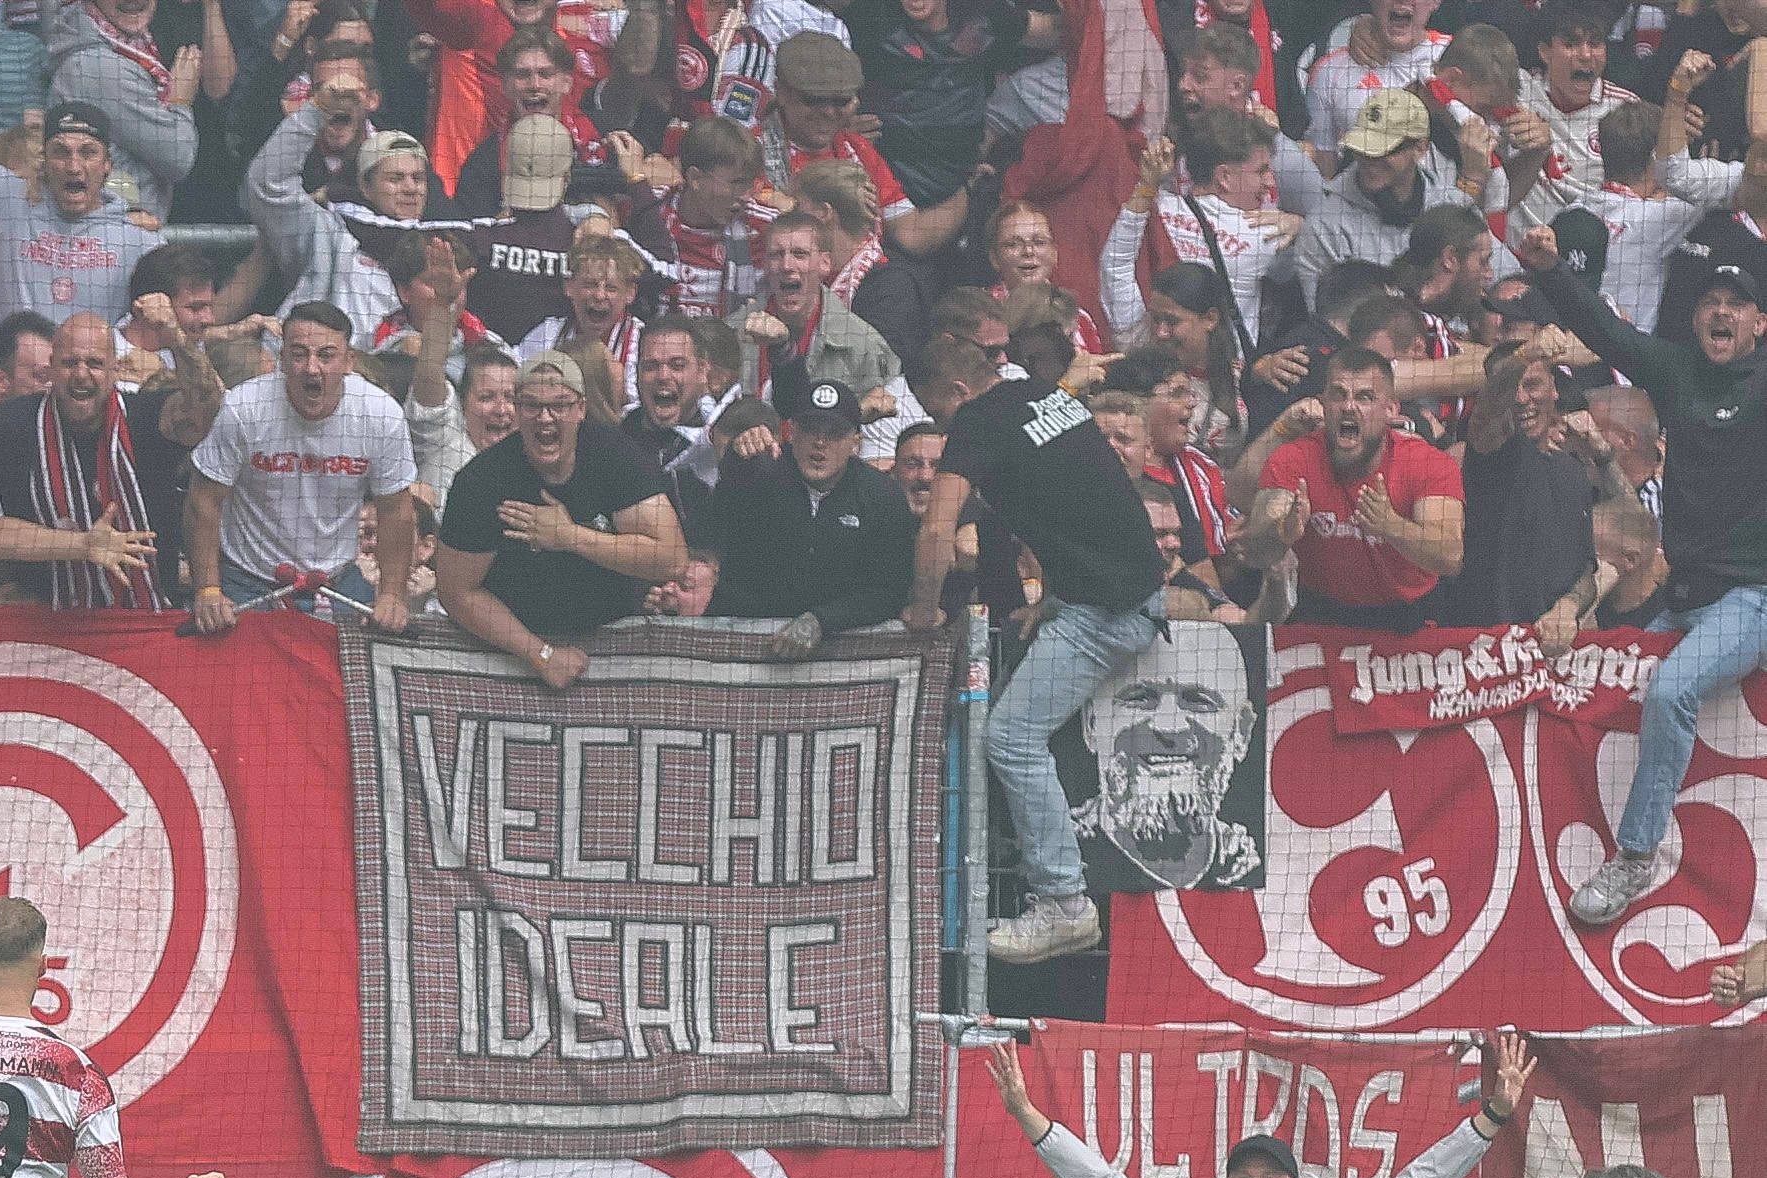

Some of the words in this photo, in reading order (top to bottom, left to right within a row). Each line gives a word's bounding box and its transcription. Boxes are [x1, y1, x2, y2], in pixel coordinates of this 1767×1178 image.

[412, 714, 879, 885] VECCHIO
[1363, 857, 1451, 947] 95
[457, 908, 839, 1061] IDEALE
